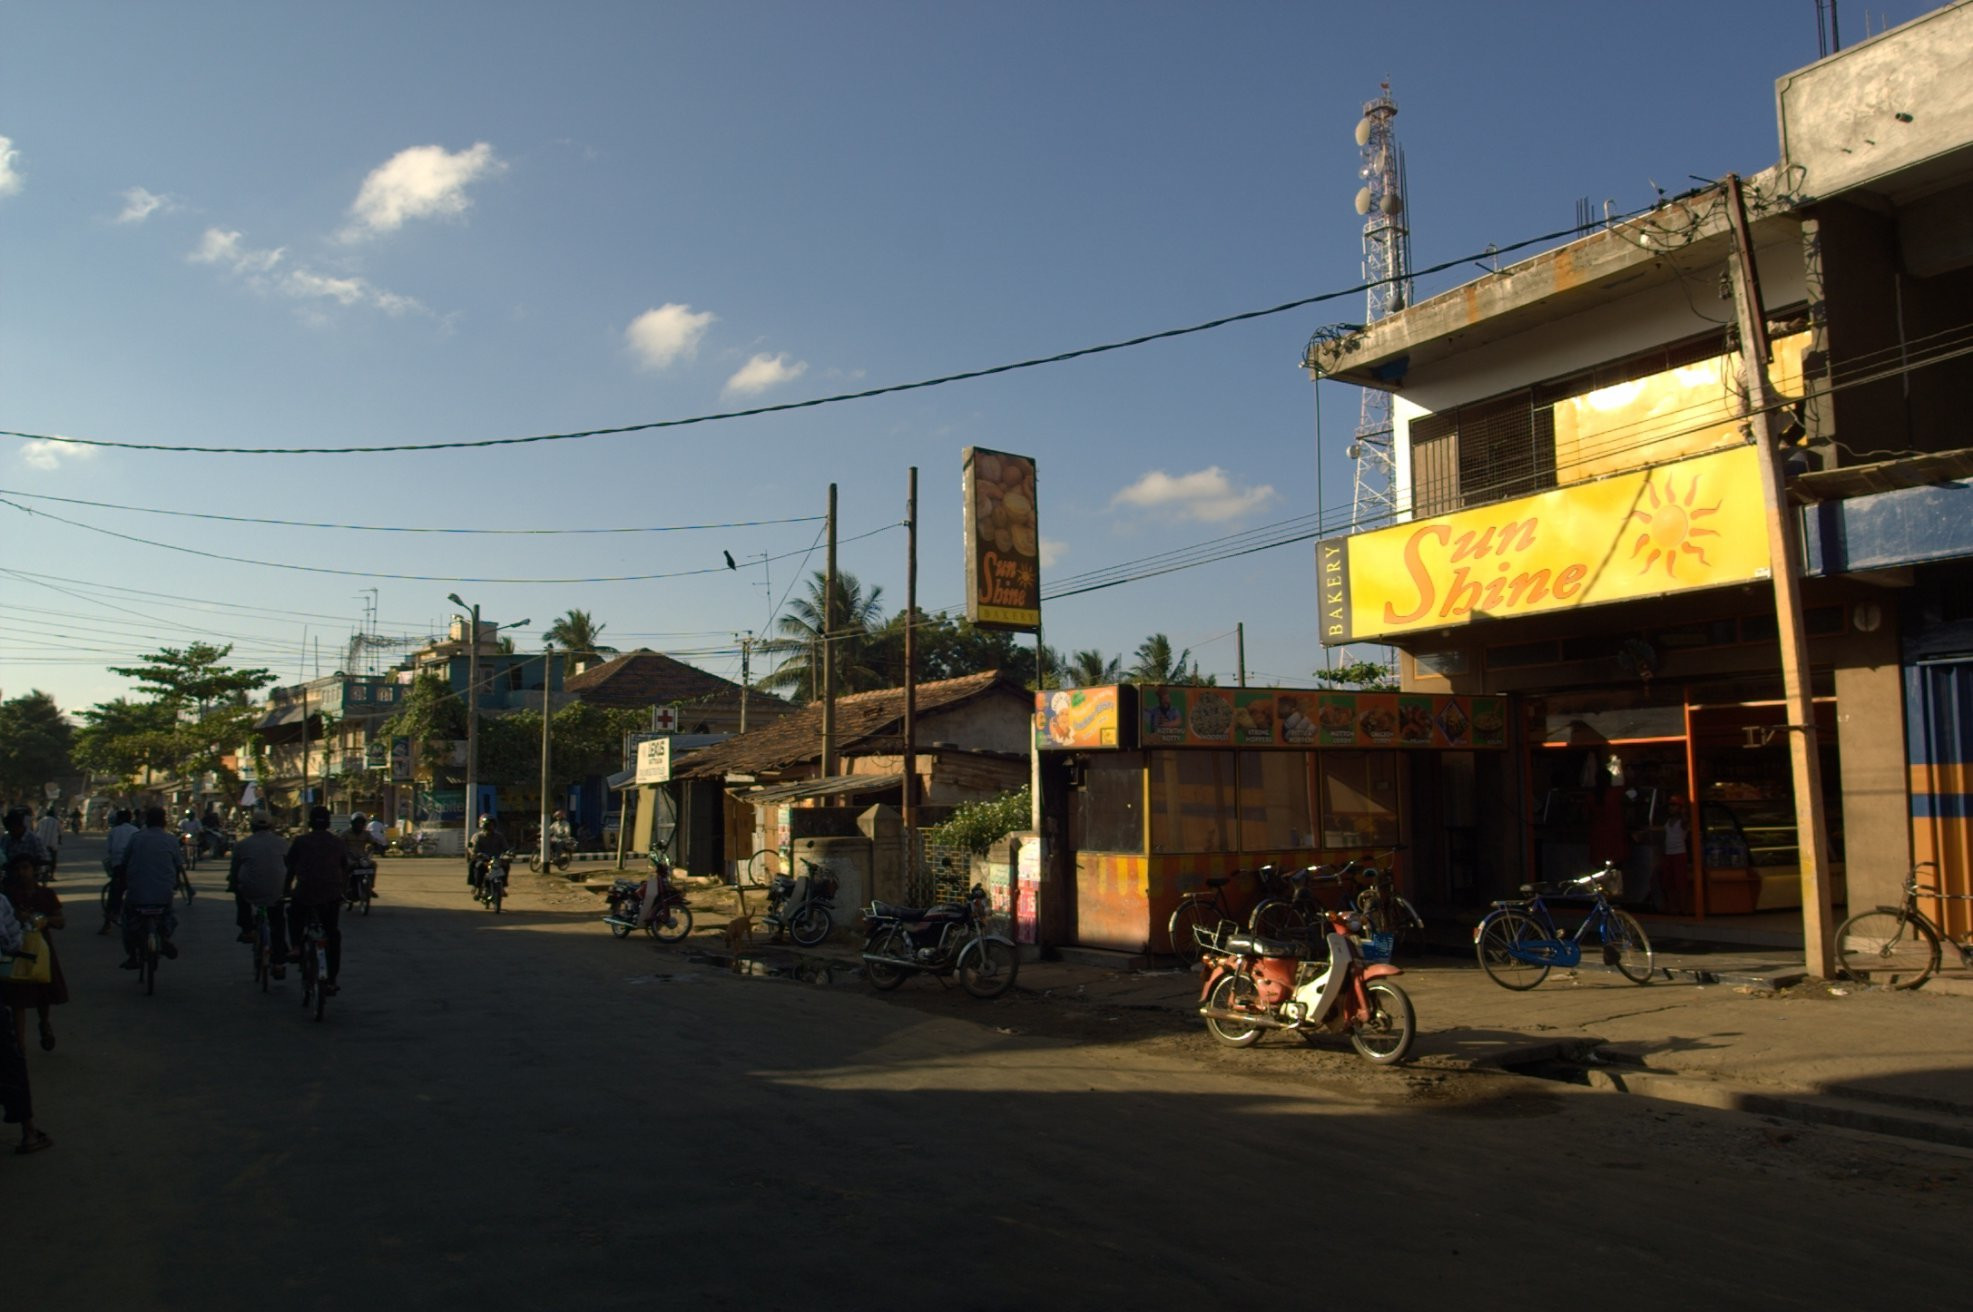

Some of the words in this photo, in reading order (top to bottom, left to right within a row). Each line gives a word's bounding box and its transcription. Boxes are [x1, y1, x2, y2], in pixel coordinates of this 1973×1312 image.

[979, 551, 1017, 603] Sun
[1324, 546, 1344, 637] BAKERY
[1384, 517, 1538, 625] Sun
[983, 608, 1035, 621] BAKERY
